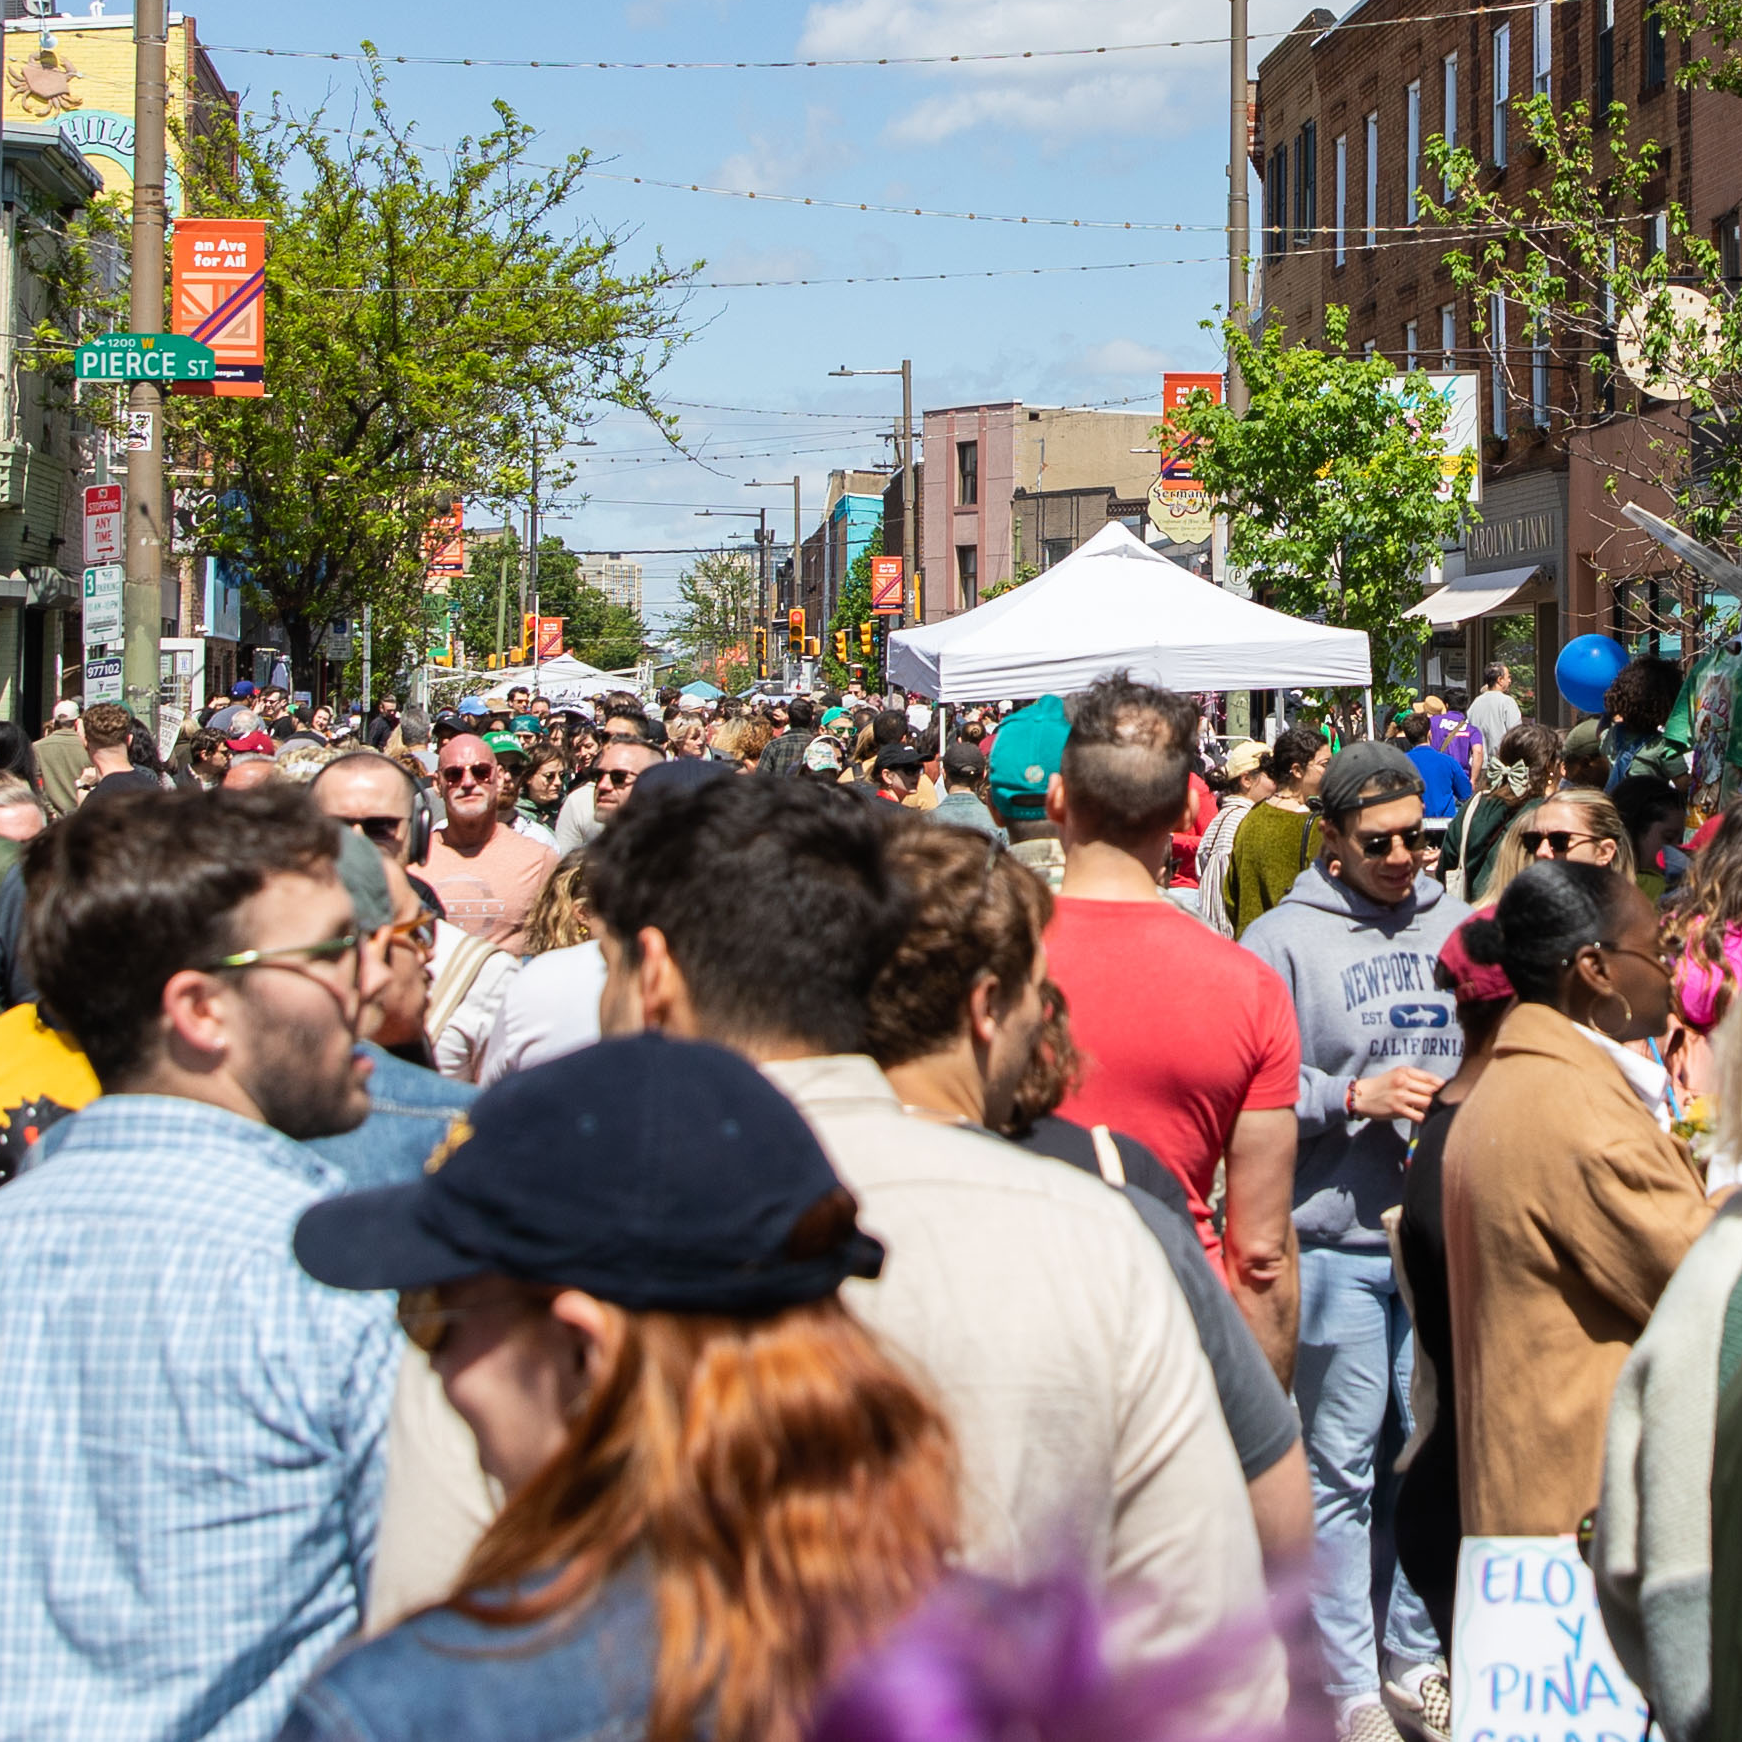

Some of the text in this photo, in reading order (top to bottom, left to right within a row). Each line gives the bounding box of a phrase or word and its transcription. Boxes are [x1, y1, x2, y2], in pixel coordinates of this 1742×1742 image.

[194, 239, 247, 252] an Ave
[194, 254, 247, 268] for All
[108, 337, 155, 349] 1200 W
[82, 352, 209, 377] PIERCE ST
[87, 499, 119, 513] STOPPING
[95, 517, 112, 531] ANY
[94, 530, 113, 544] TIME
[1466, 513, 1553, 562] CAROLYN ZINNI
[86, 574, 95, 595] 3
[87, 662, 120, 678] 977102
[1339, 951, 1426, 1013] NEWPORT
[1361, 1011, 1388, 1026] EST.
[1369, 1037, 1465, 1058] CALIFORNIA
[1556, 1613, 1586, 1662] Y
[1479, 1652, 1621, 1717] PIÑA
